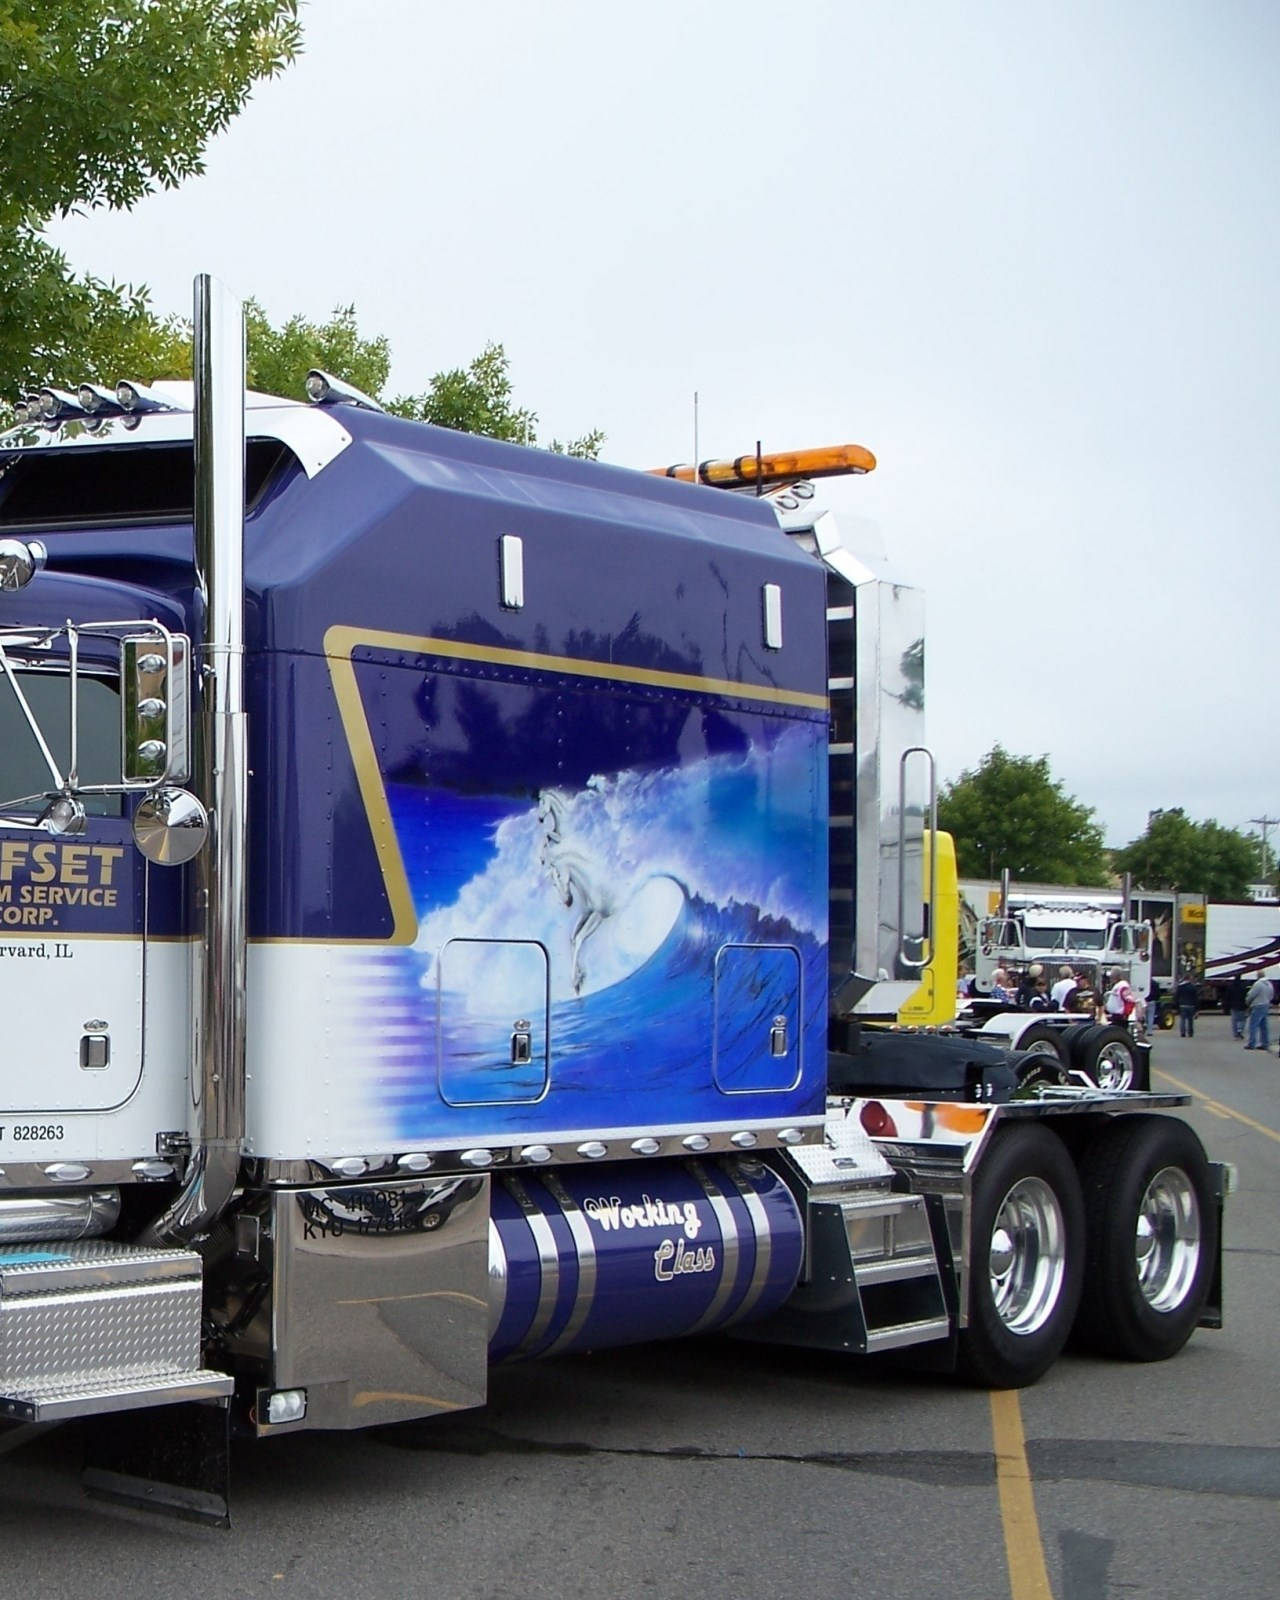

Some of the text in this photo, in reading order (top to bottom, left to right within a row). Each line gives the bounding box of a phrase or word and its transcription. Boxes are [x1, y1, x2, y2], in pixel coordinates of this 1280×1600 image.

[19, 885, 118, 907] SERVICE
[54, 942, 74, 958] IL
[12, 1125, 65, 1142] 828263
[583, 1194, 702, 1240] Working
[654, 1237, 716, 1281] Class
